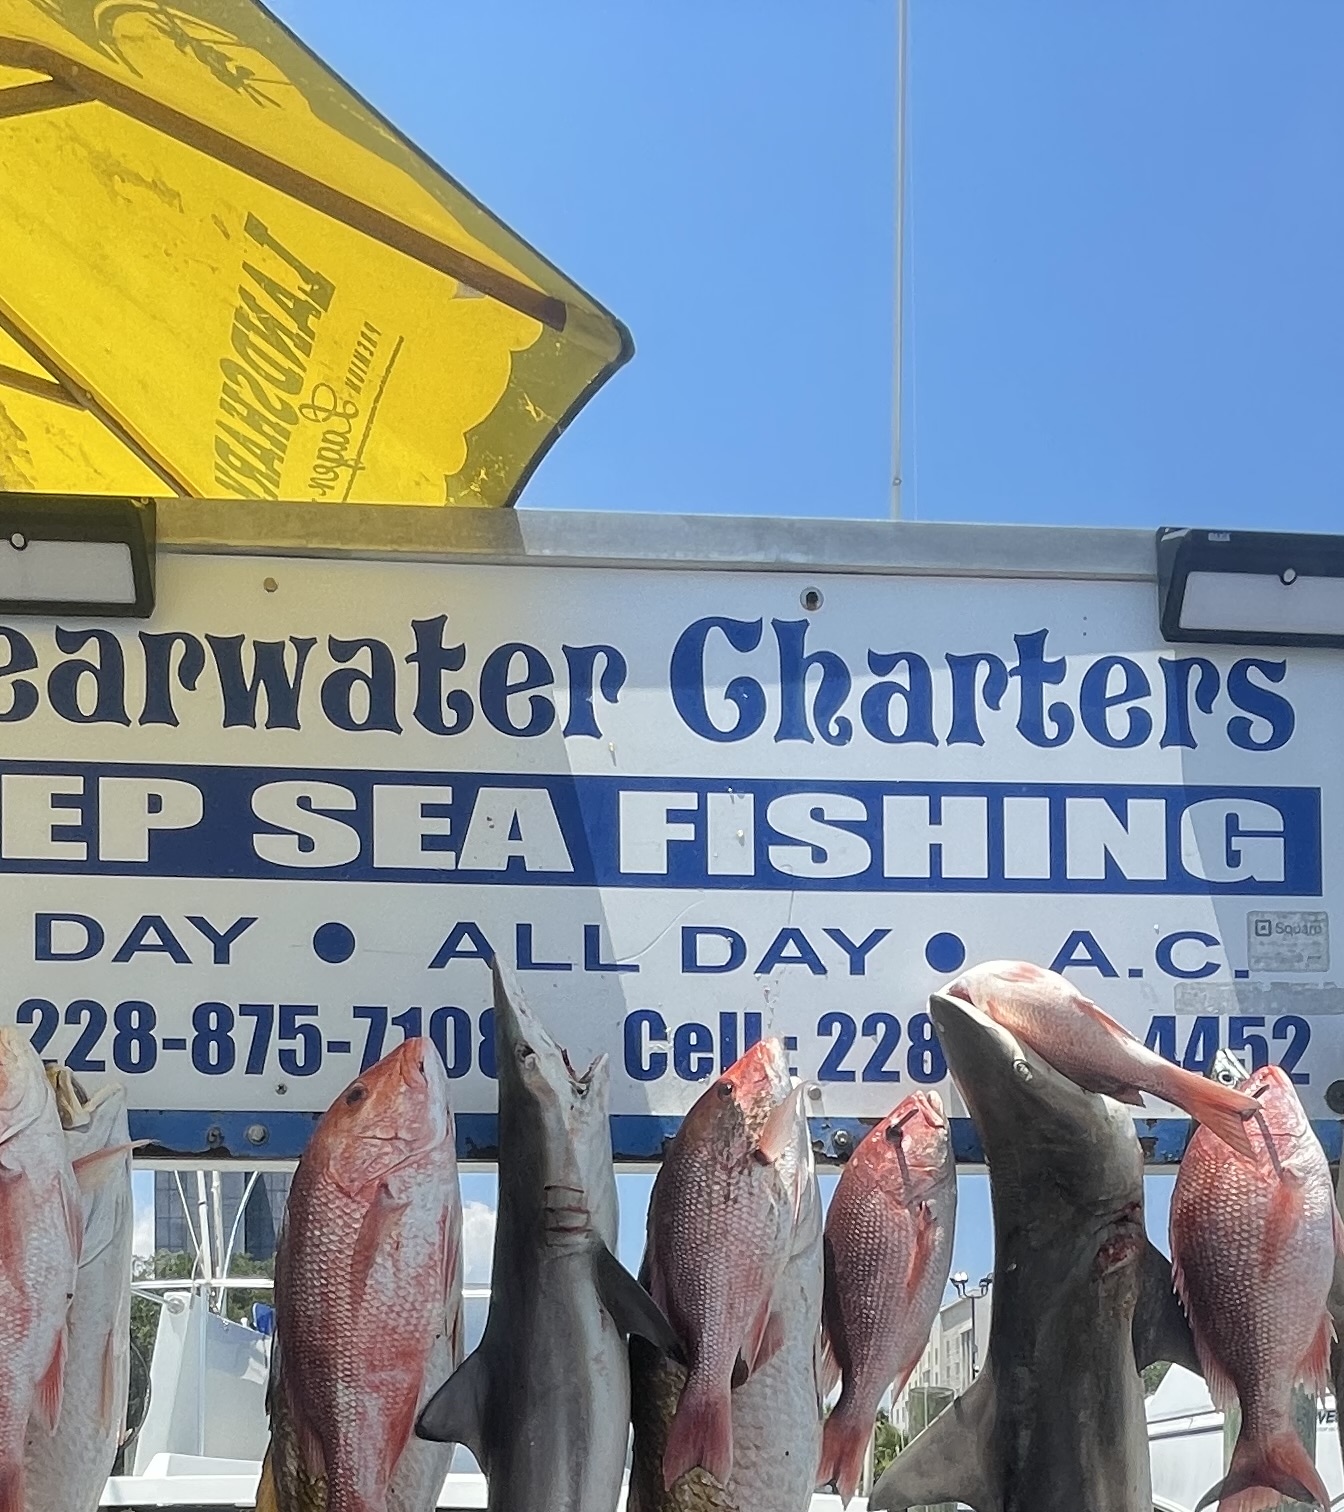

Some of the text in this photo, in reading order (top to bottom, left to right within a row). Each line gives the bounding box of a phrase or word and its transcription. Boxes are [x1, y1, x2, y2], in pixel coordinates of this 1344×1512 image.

[670, 615, 1297, 750] Charters
[251, 780, 575, 873] SEA
[618, 789, 1286, 884] FISHING
[34, 912, 259, 966] DAY
[427, 921, 641, 974] ALL
[680, 926, 893, 976] DAY
[1047, 929, 1250, 980] A.C.
